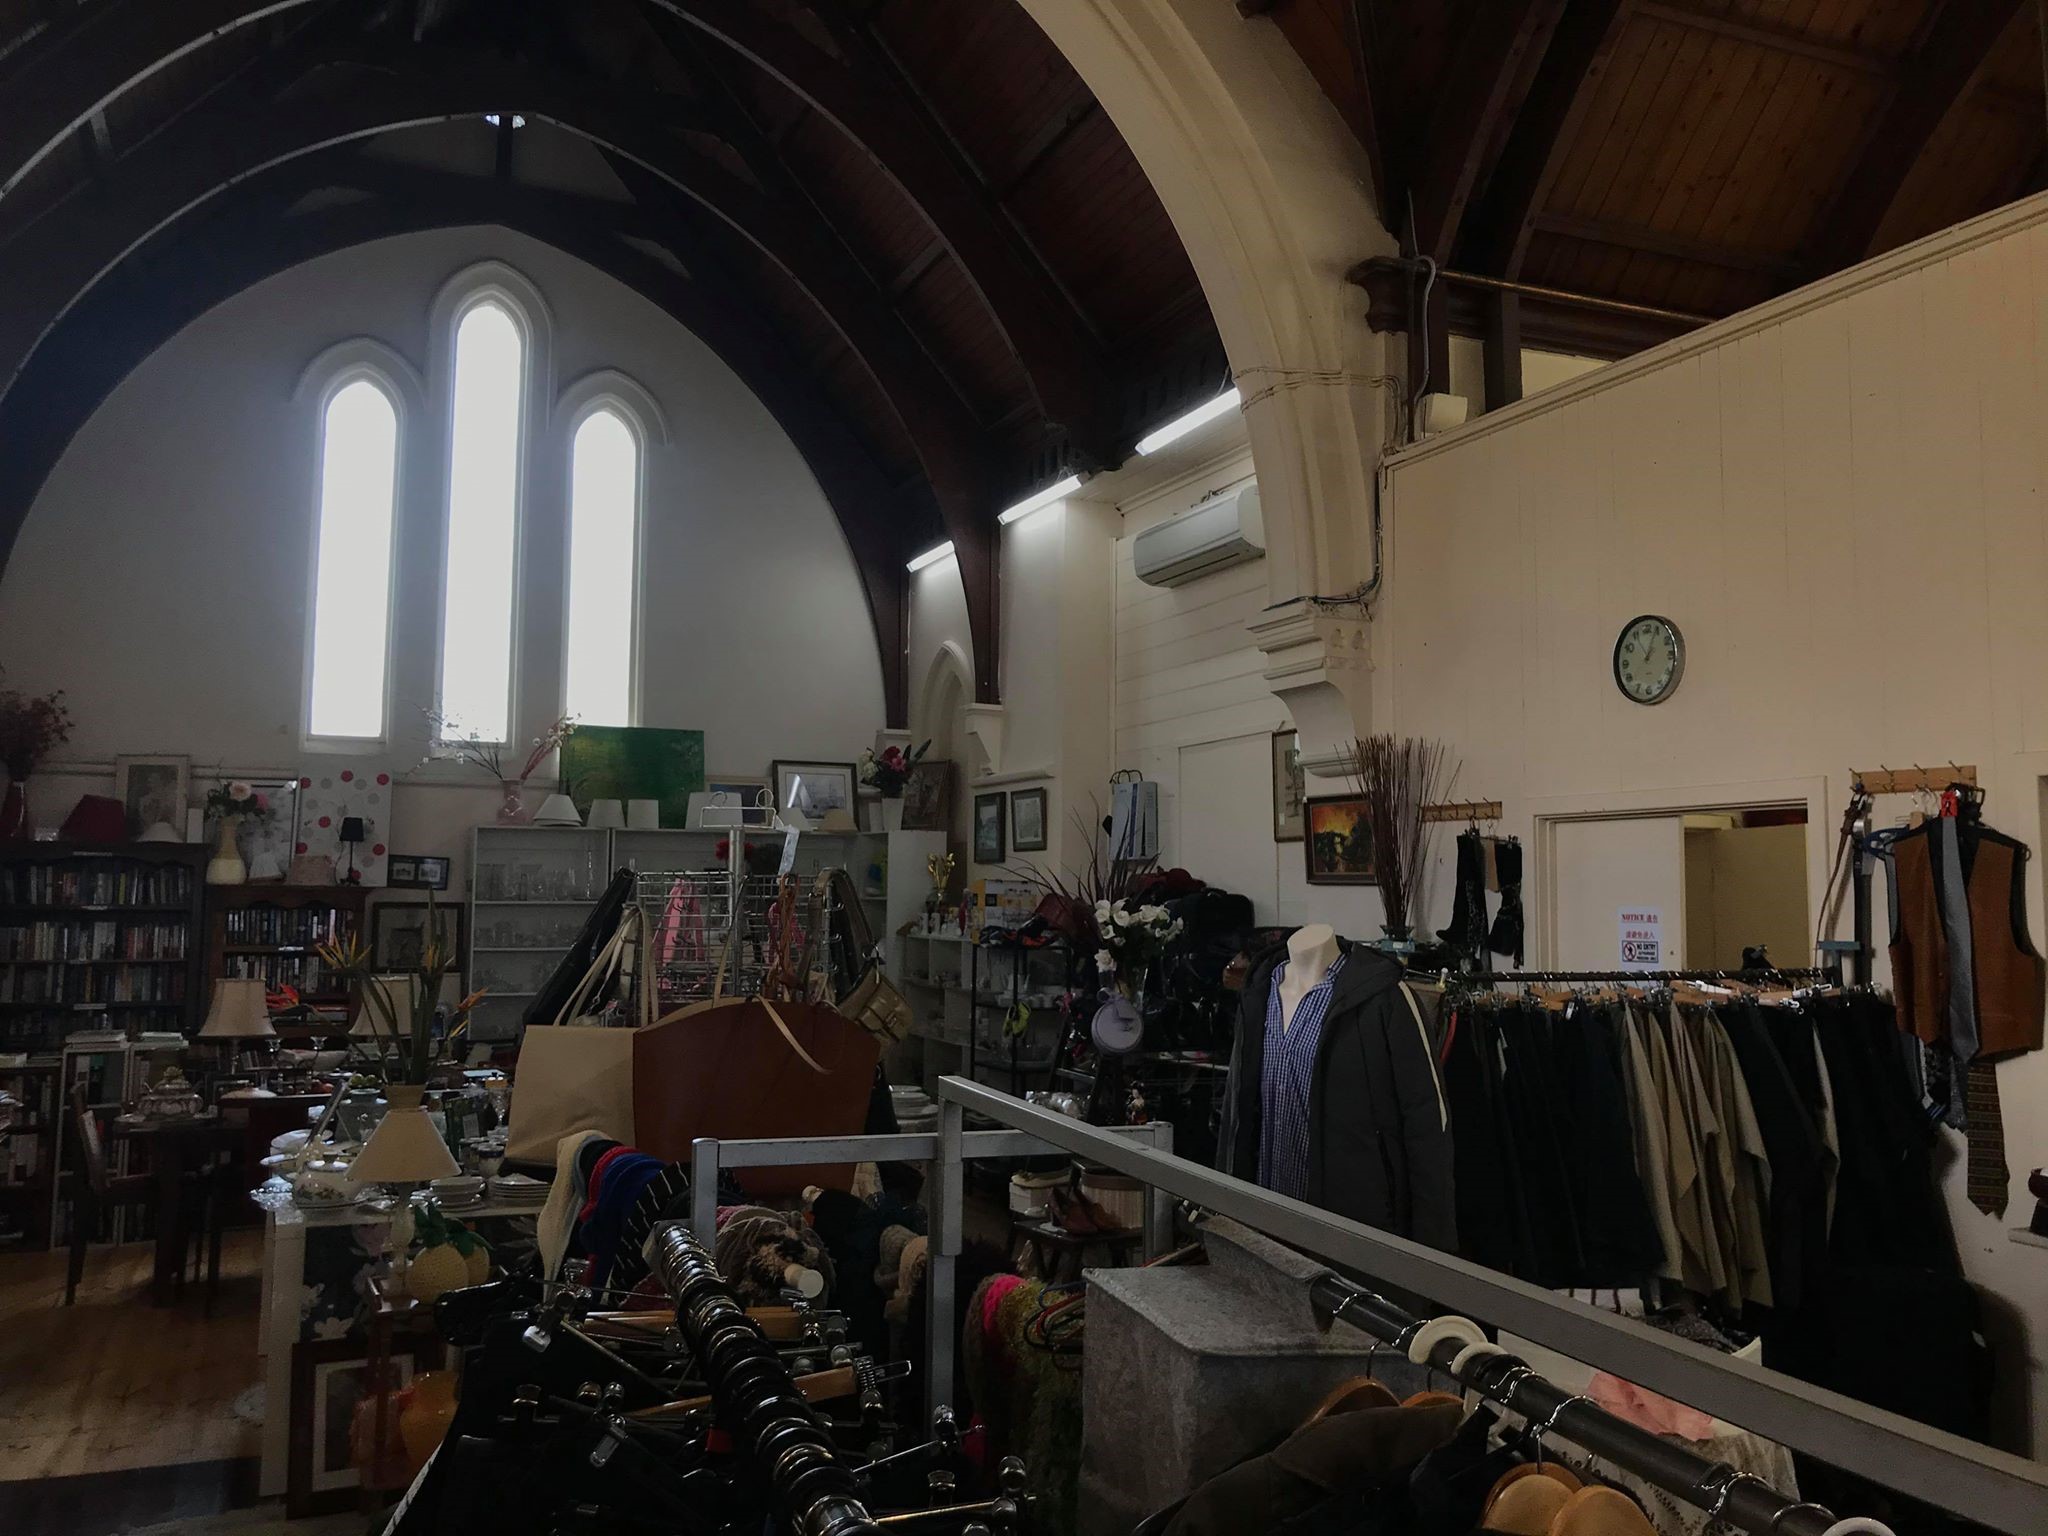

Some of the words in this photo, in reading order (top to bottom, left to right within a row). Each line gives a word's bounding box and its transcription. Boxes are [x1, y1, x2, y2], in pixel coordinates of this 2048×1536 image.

[1625, 643, 1634, 653] 10
[1623, 660, 1629, 668] 9
[1626, 673, 1633, 681] 8
[1635, 683, 1641, 693] 7
[1646, 686, 1652, 694] 6
